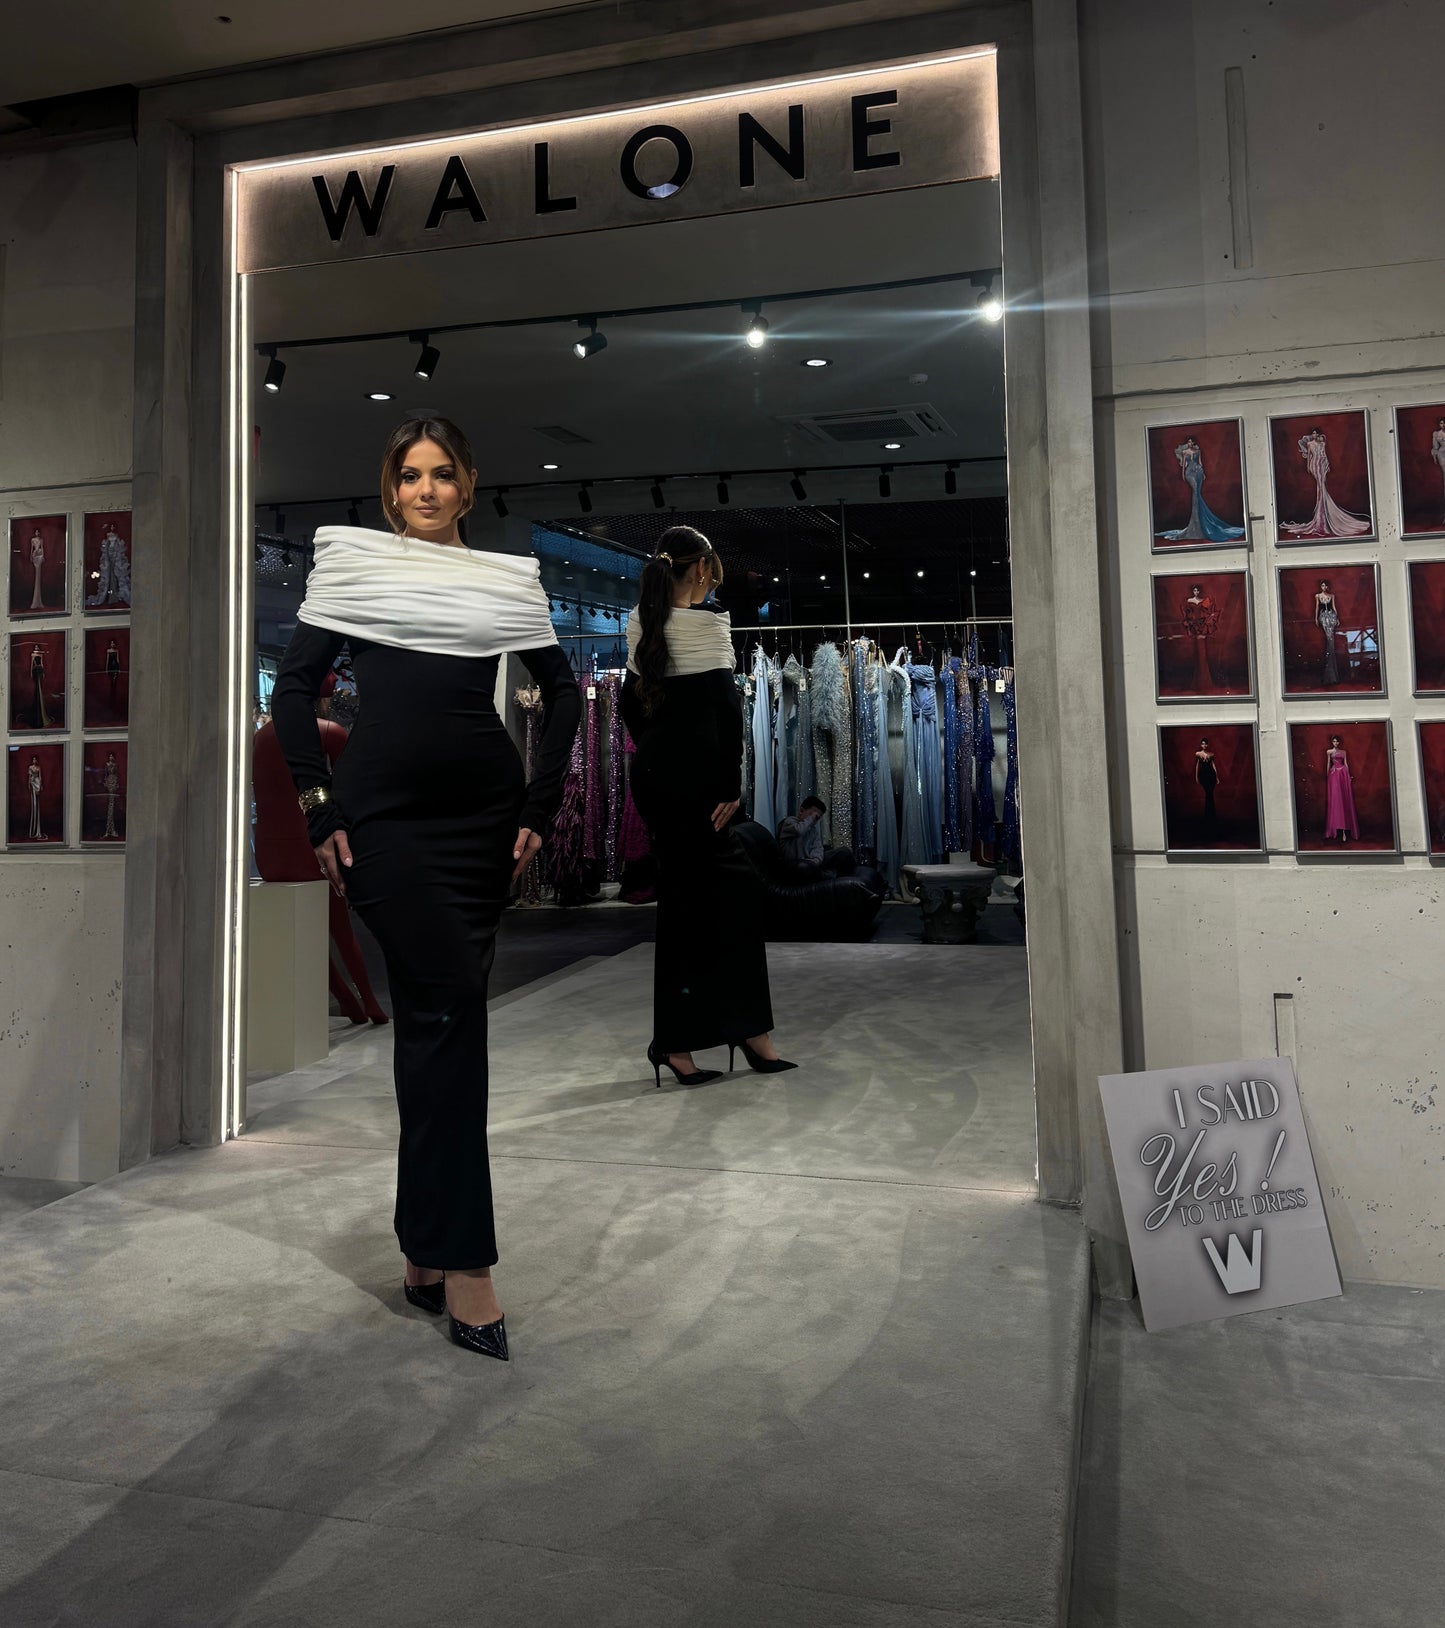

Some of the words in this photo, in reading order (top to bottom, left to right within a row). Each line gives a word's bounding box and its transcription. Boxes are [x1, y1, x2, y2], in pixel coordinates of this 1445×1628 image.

[311, 89, 902, 242] WALONE
[1172, 1088, 1188, 1130] I
[1197, 1078, 1280, 1127] SAID
[1176, 1204, 1204, 1227] TO
[1209, 1197, 1248, 1222] THE
[1252, 1187, 1308, 1216] DRESS
